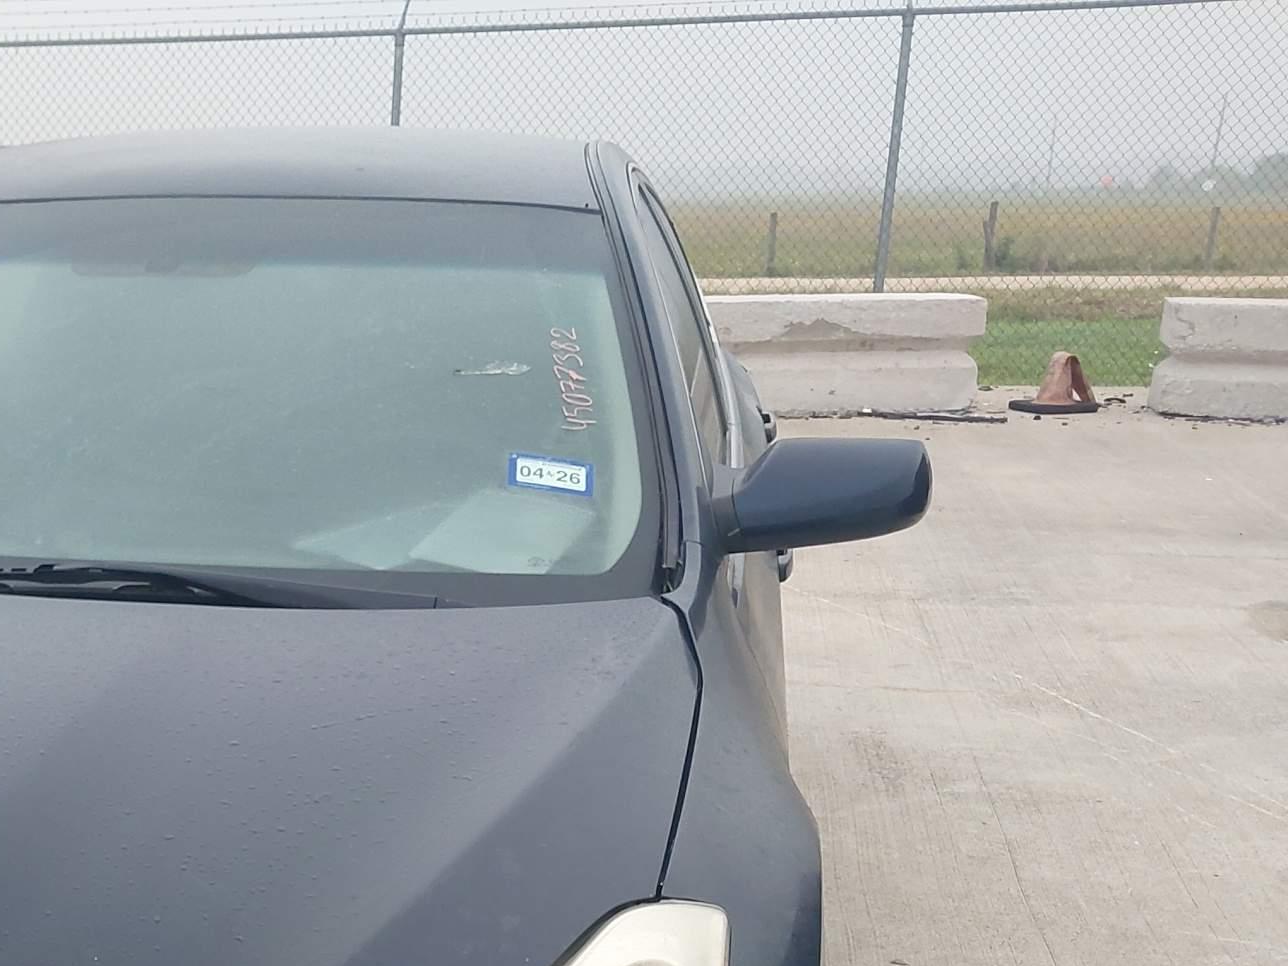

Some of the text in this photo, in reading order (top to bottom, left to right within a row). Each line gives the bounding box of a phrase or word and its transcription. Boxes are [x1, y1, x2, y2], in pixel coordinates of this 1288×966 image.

[550, 327, 597, 431] 45077382
[519, 465, 544, 479] 04
[556, 470, 581, 485] 26
